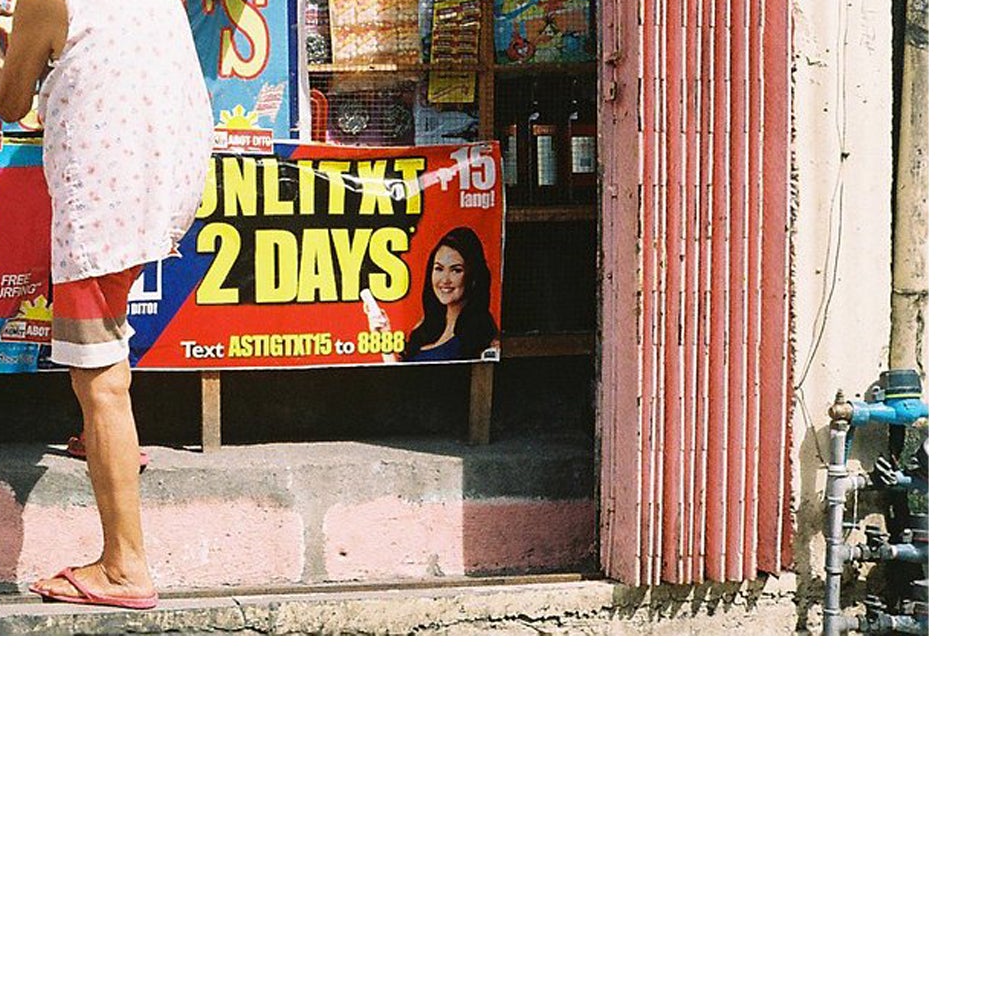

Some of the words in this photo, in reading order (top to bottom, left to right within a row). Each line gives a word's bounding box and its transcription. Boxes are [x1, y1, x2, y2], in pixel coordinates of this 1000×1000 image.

[252, 135, 271, 147] DITO
[460, 190, 495, 208] lang!
[196, 221, 242, 305] 2
[0, 273, 31, 287] FREE
[26, 326, 50, 337] ABOT
[181, 341, 224, 358] Text
[229, 333, 332, 358] ASTIGTXT15
[335, 340, 355, 355] to
[358, 331, 405, 354] 8888
